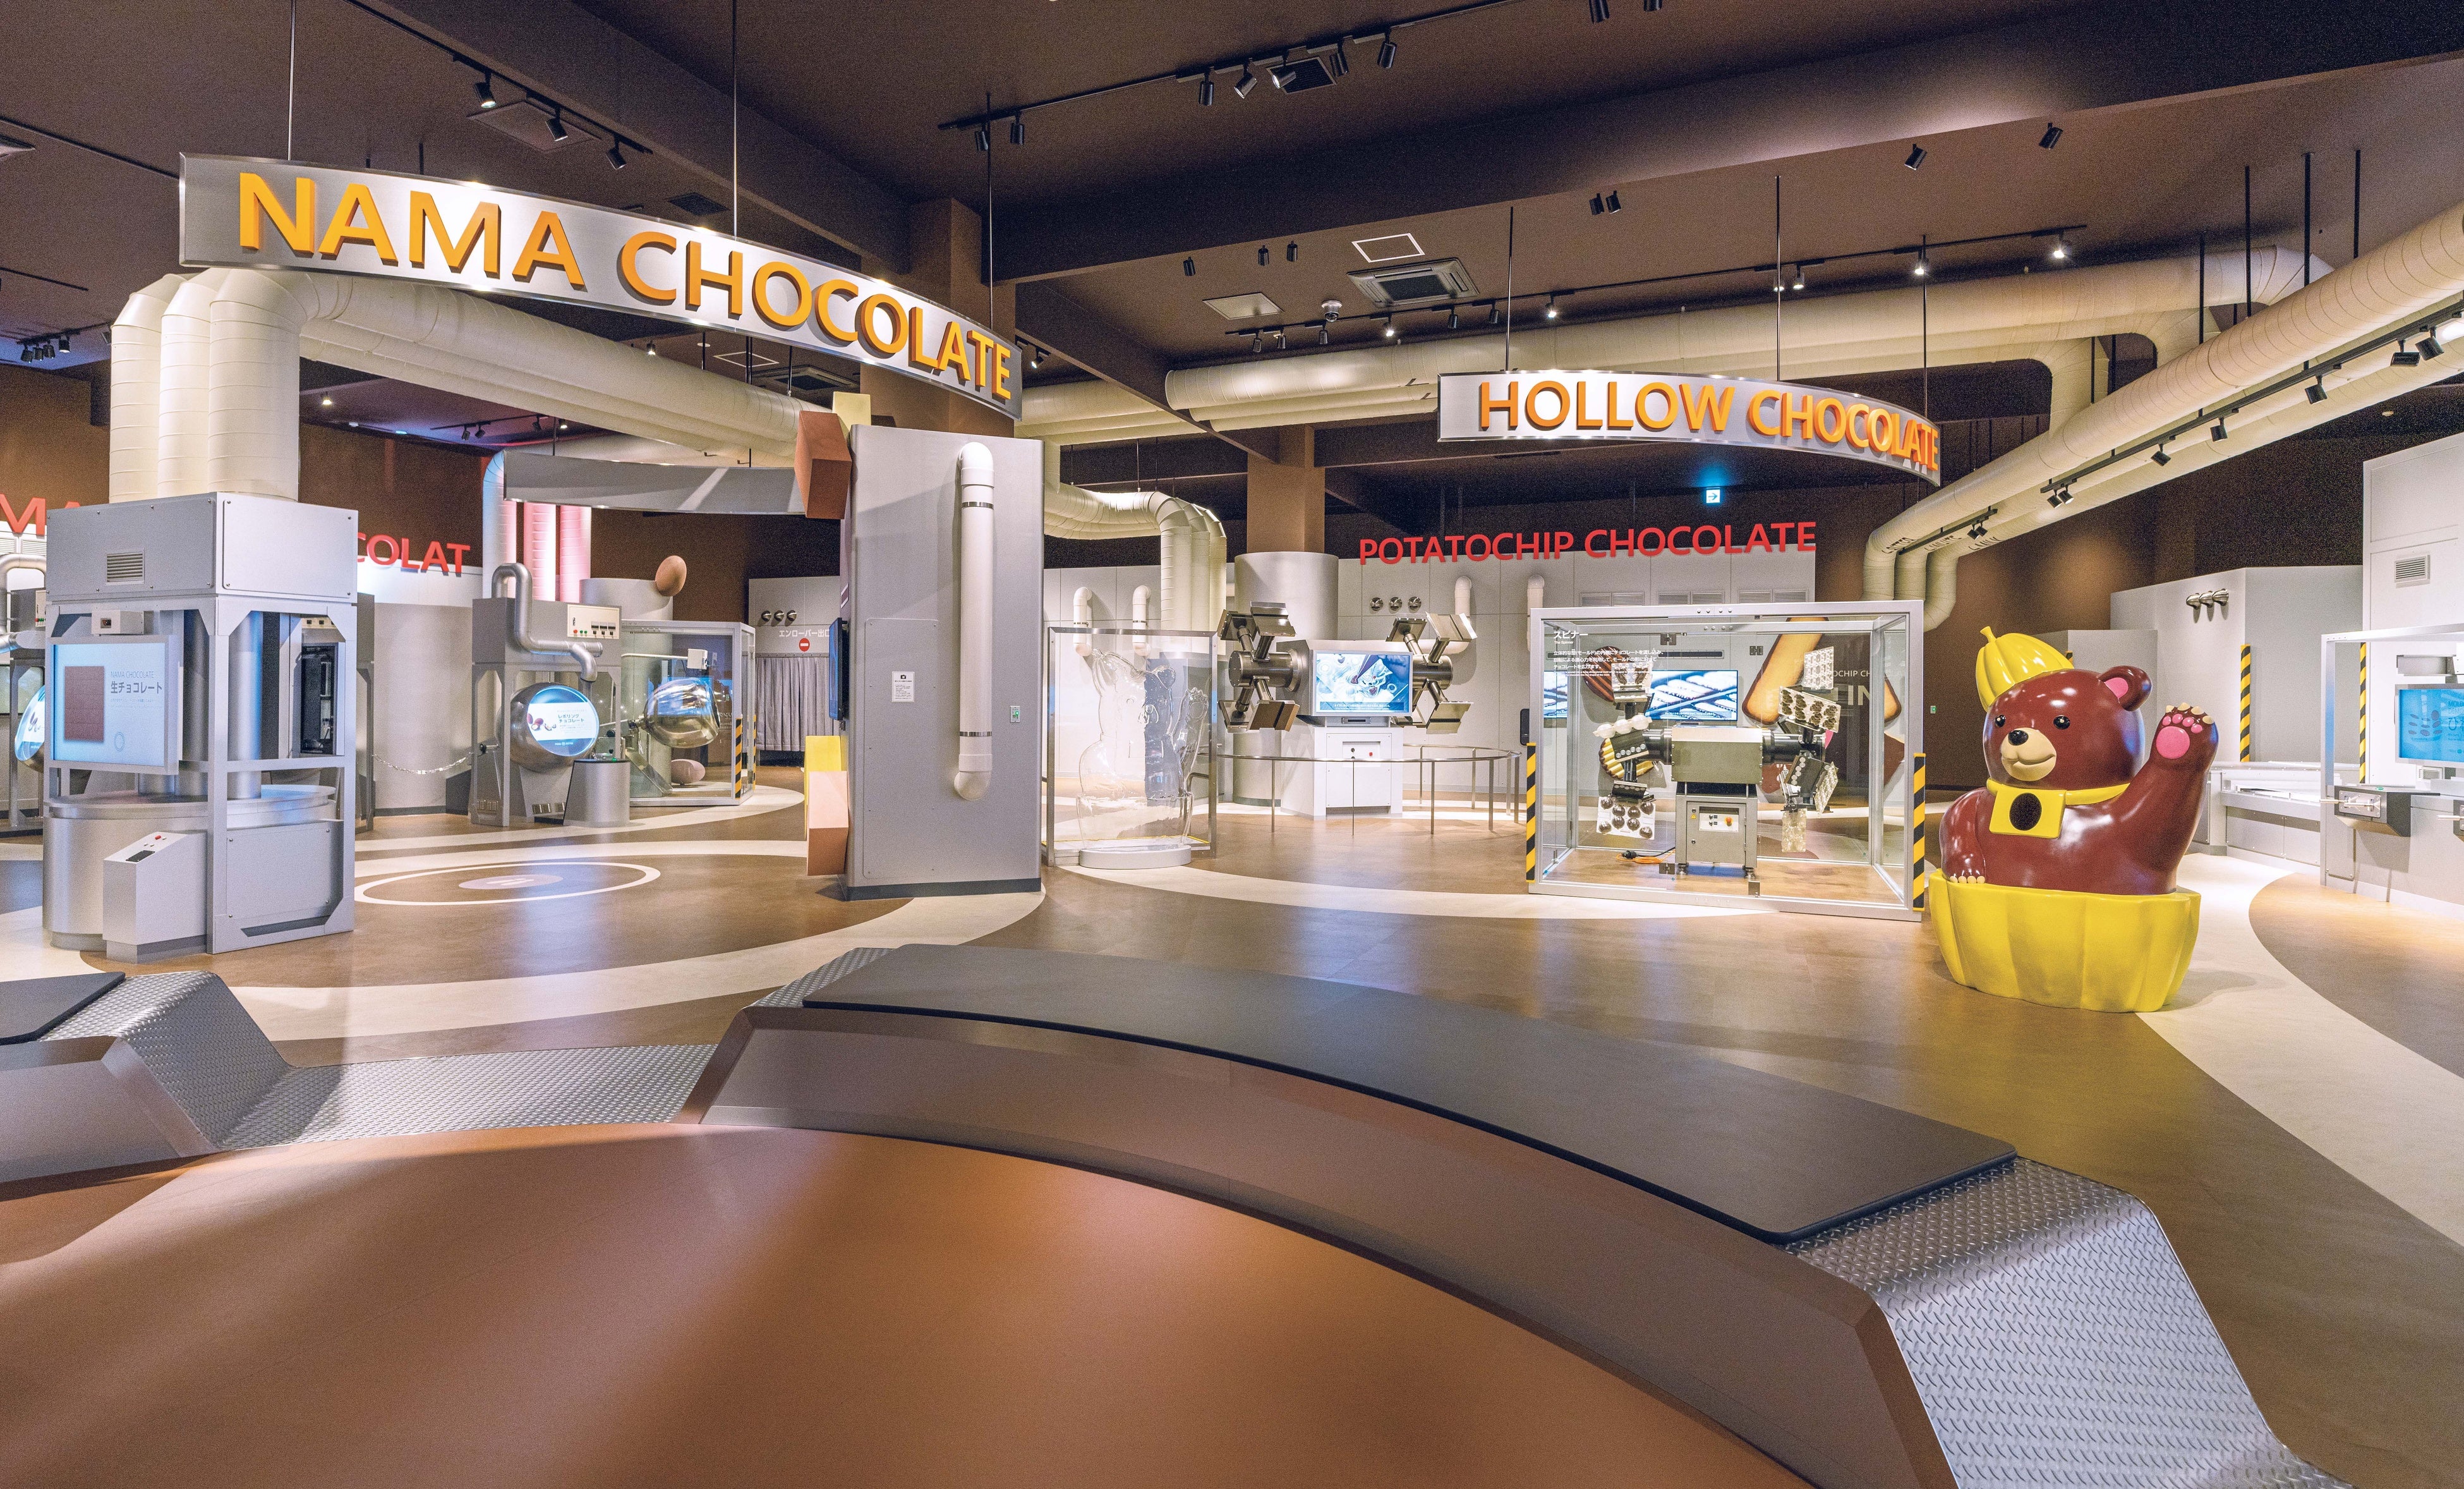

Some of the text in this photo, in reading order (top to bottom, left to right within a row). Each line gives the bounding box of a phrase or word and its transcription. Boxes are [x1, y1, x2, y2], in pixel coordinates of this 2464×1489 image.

[239, 173, 1012, 400] NAMA CHOCOLATE
[1480, 380, 1938, 471] HOLLOW CHOCOLATE
[1360, 521, 1817, 564] POTATOCHIP CHOCOLATE
[779, 629, 830, 637] エンローバー出口
[1554, 630, 1588, 639] スピナー
[111, 681, 162, 694] 生チョコレート
